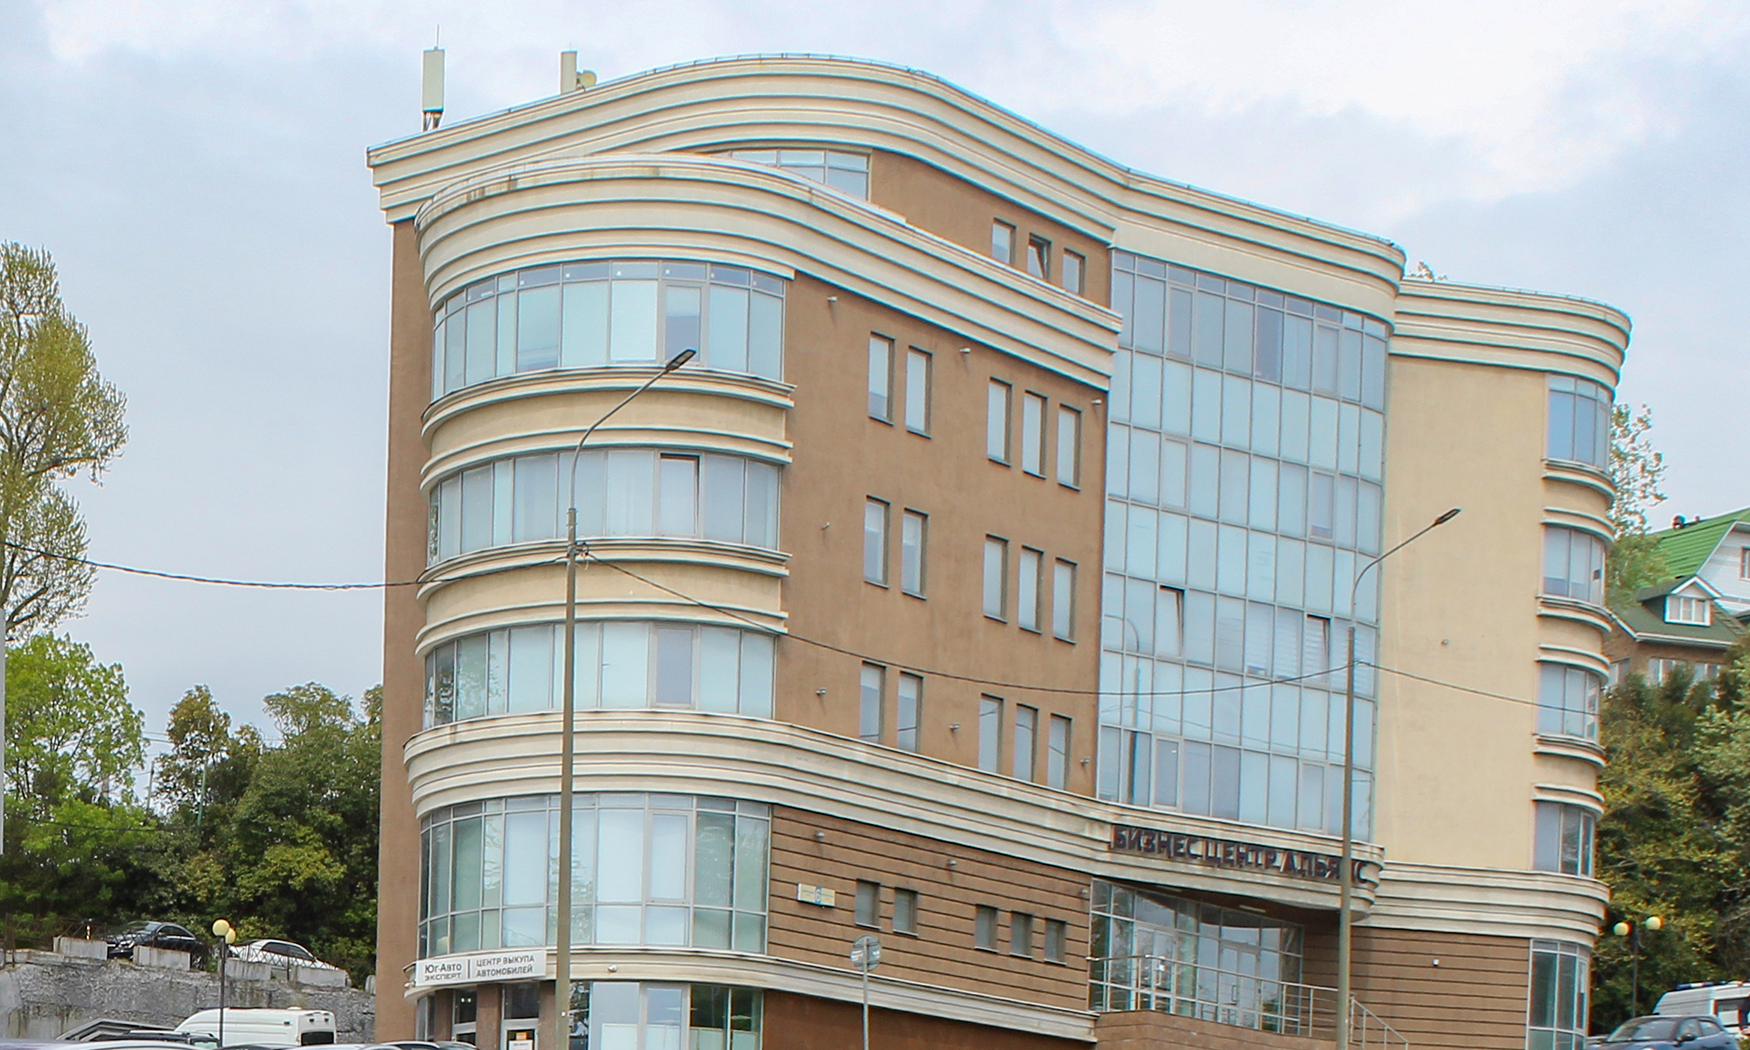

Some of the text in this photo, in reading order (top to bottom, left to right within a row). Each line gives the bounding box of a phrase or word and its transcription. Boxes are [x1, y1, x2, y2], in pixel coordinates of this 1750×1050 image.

[1111, 824, 1368, 884] БИЗНЕС ЦЕНТР АЛЬЯС
[476, 955, 535, 967] ЦЕНТР ВЫКУПА
[424, 972, 462, 981] ЭКСПЕРТ
[476, 964, 533, 978] АВТОМОБИЛЕЙ
